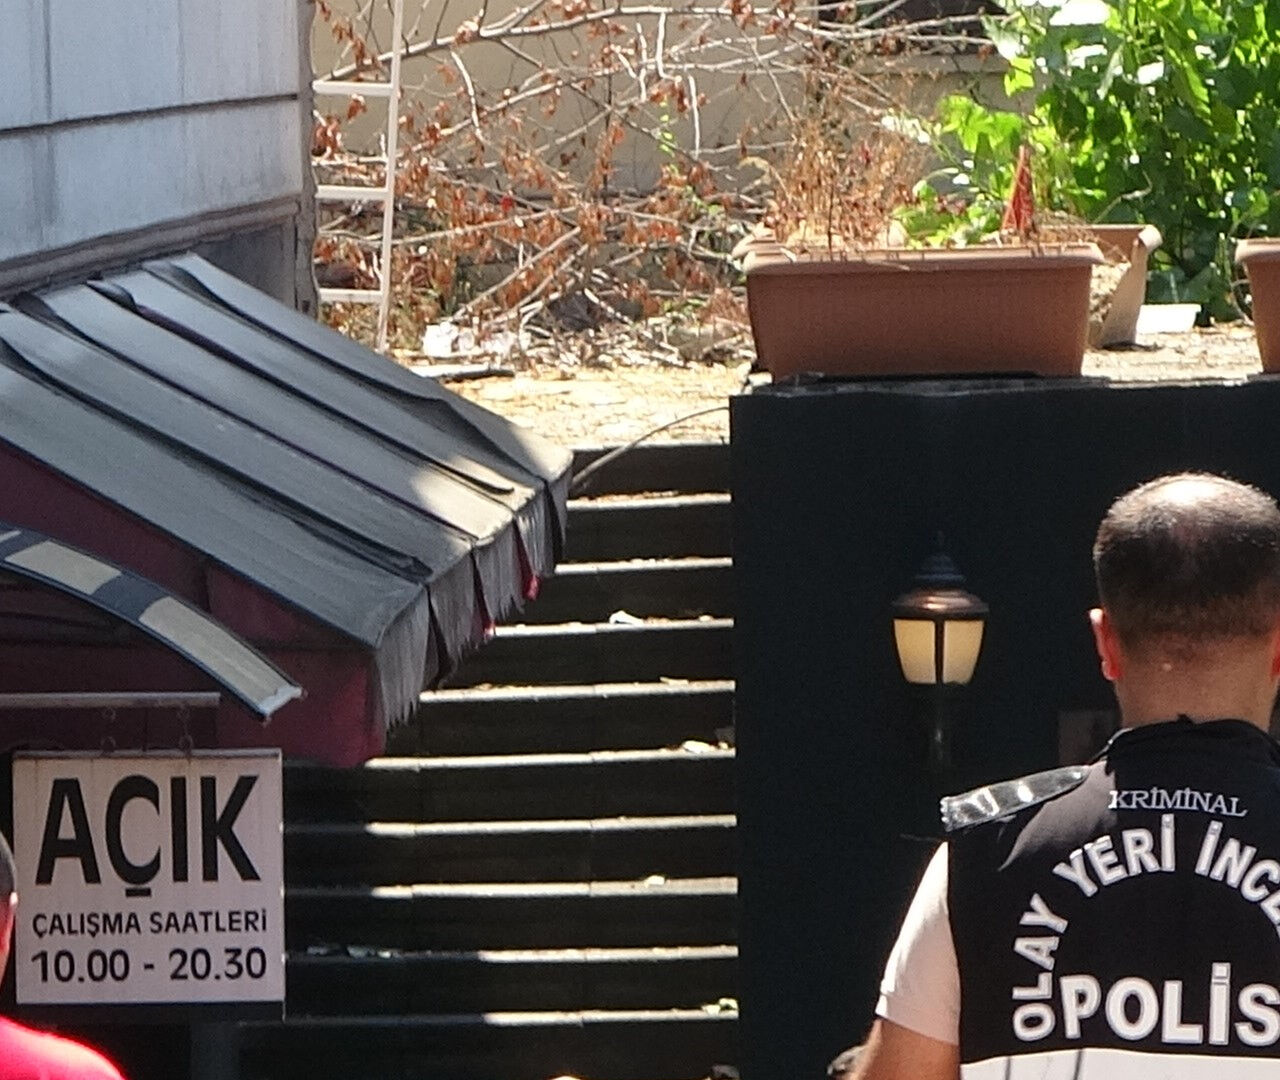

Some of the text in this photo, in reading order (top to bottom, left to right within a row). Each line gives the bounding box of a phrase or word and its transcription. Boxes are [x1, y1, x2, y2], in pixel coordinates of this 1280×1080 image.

[1108, 785, 1248, 818] KRİMİNAL
[34, 774, 261, 898] AÇIK
[31, 908, 268, 939] ÇALIŞMA SAATLERİ
[1011, 893, 1071, 1043] OLAY
[1052, 813, 1176, 898] YERİ
[31, 949, 131, 983] 10.00
[168, 947, 267, 981] 20.30
